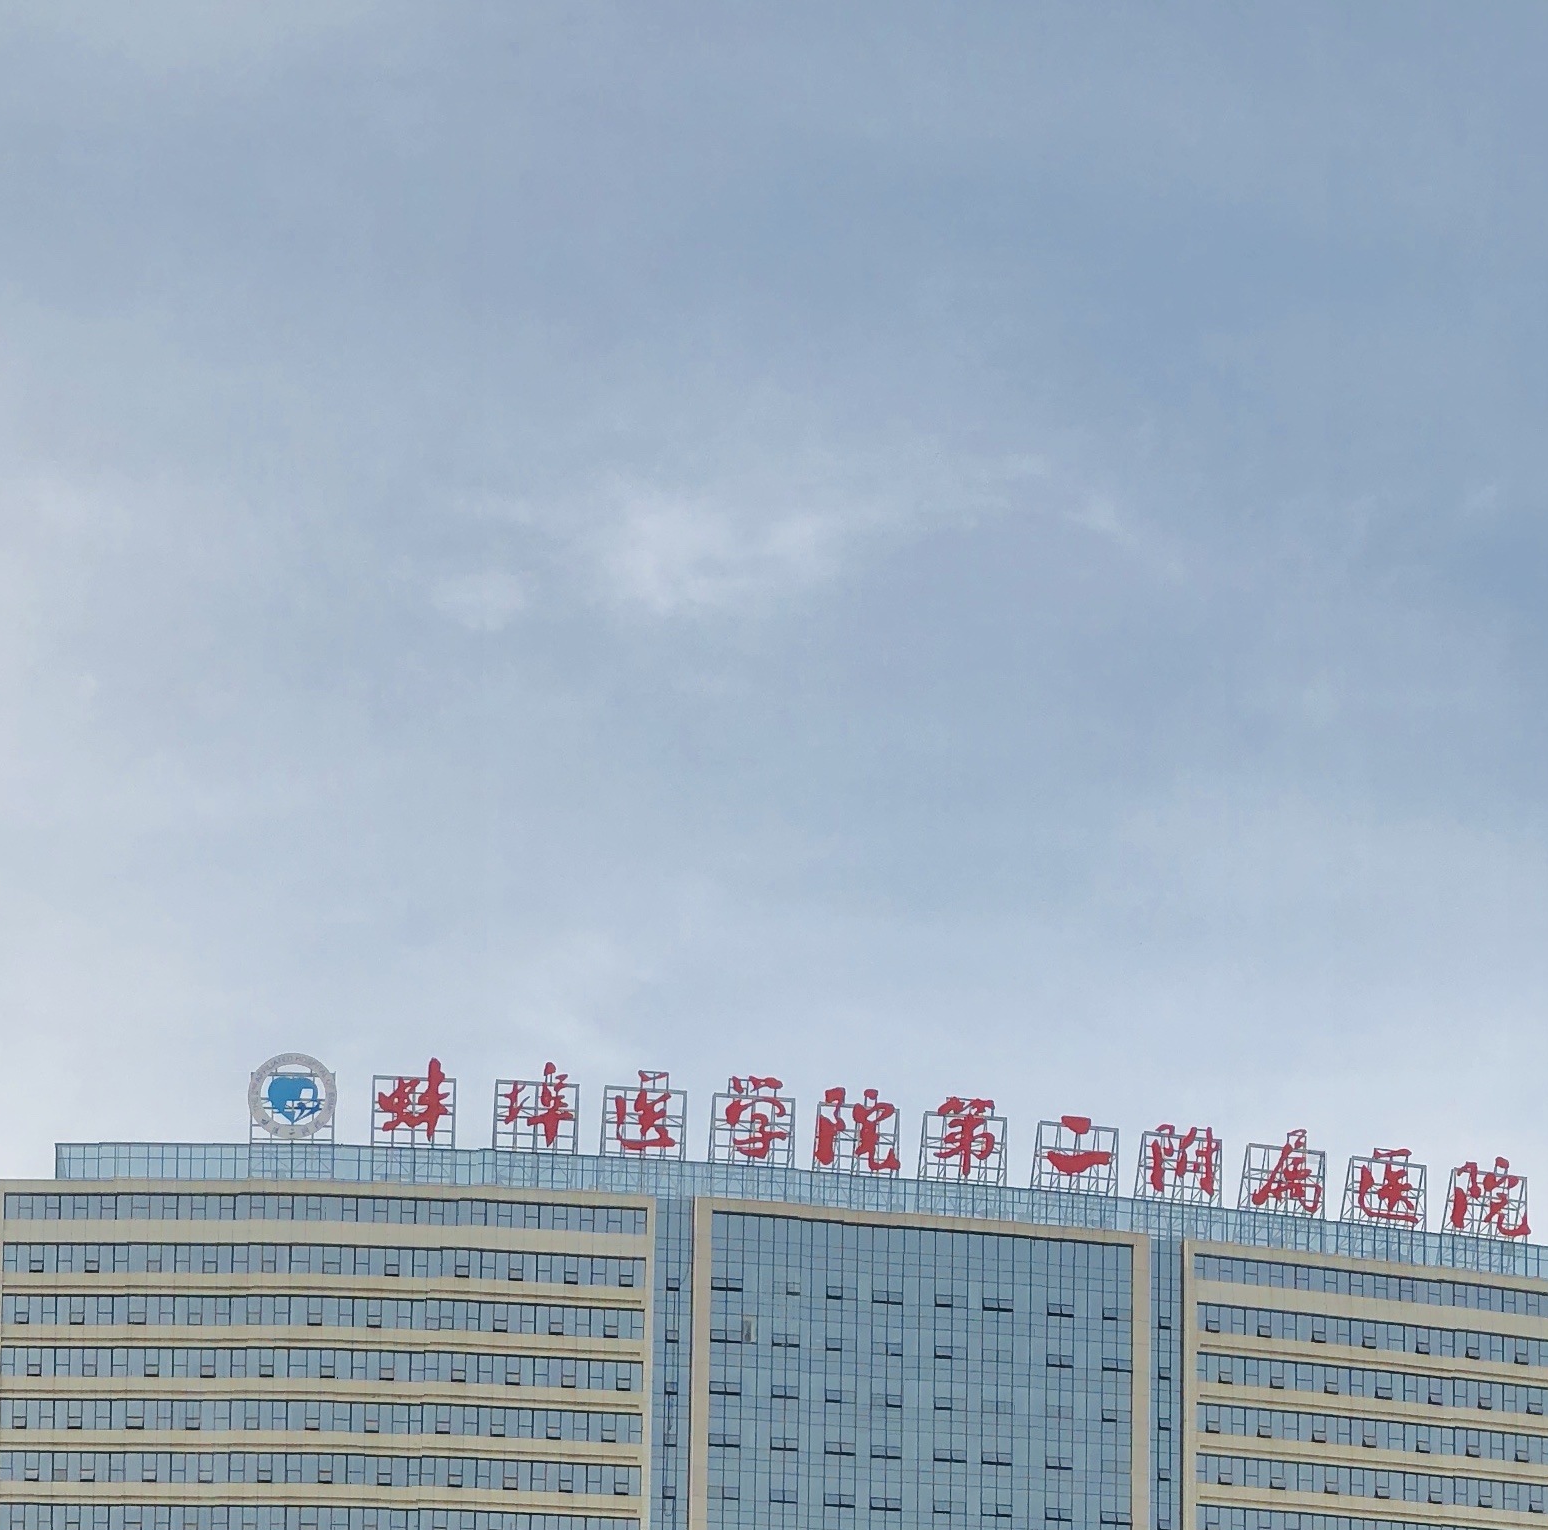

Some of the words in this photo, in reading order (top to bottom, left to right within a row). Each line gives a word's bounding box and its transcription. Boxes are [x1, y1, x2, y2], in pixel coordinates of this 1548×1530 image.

[379, 1058, 1531, 1236] 蚌埠医学院第二附属医院
